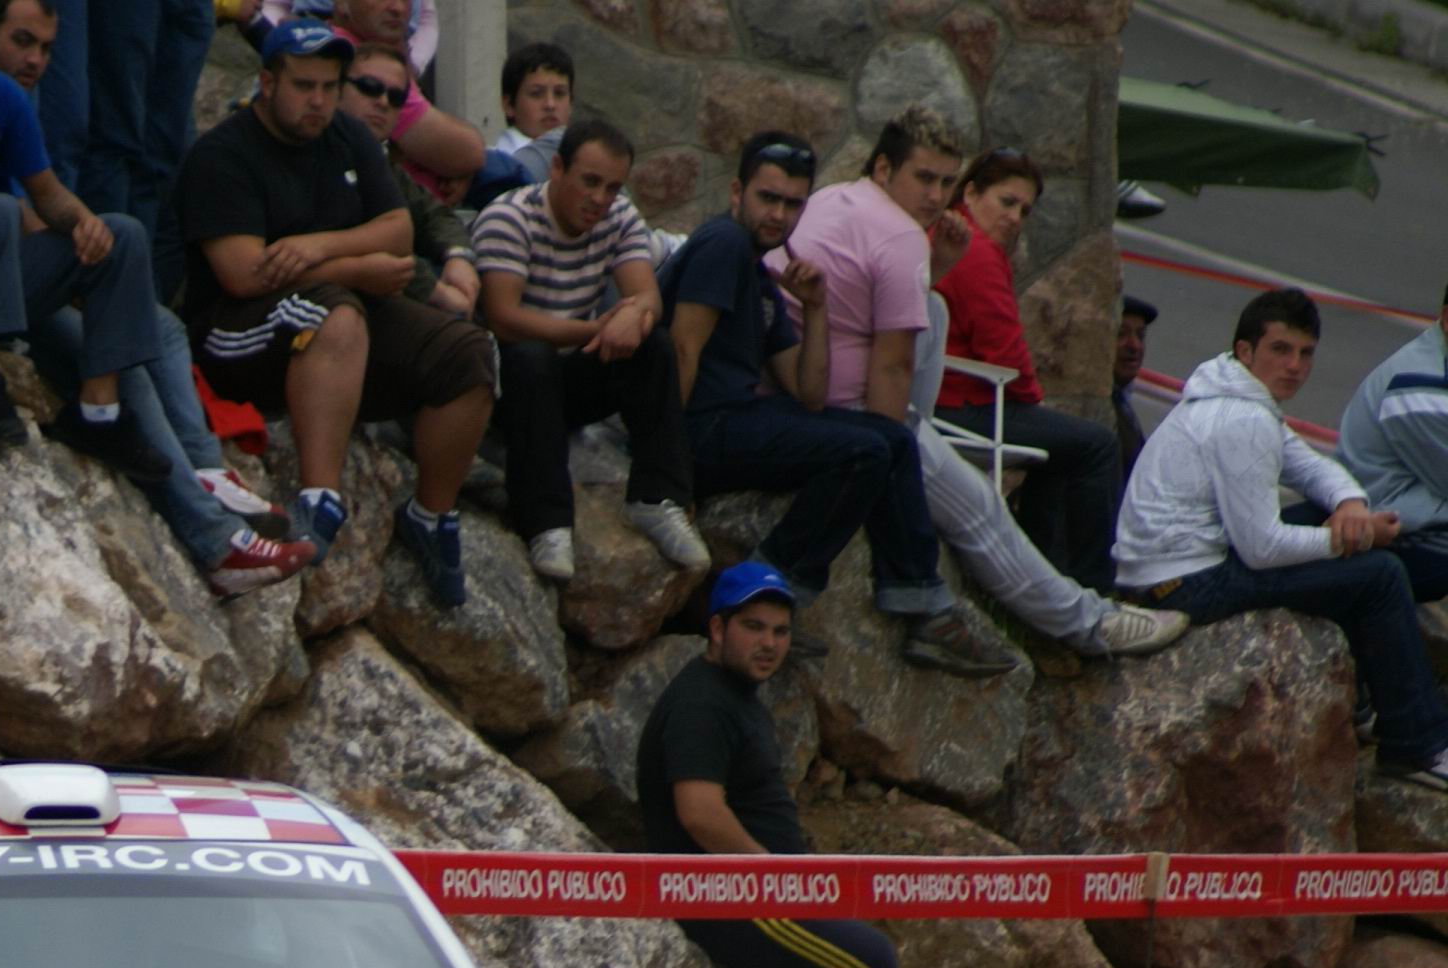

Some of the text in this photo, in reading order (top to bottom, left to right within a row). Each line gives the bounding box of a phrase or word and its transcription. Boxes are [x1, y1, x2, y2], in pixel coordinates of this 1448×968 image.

[441, 867, 627, 902] PROHIBIDO PUBLICO
[658, 871, 840, 904] PROHIBIDO PUBLICO
[872, 872, 1051, 903] PROHIBIDO PUBLICO
[1183, 871, 1262, 900] PUBLICO
[1295, 868, 1394, 899] PROHIBIDO
